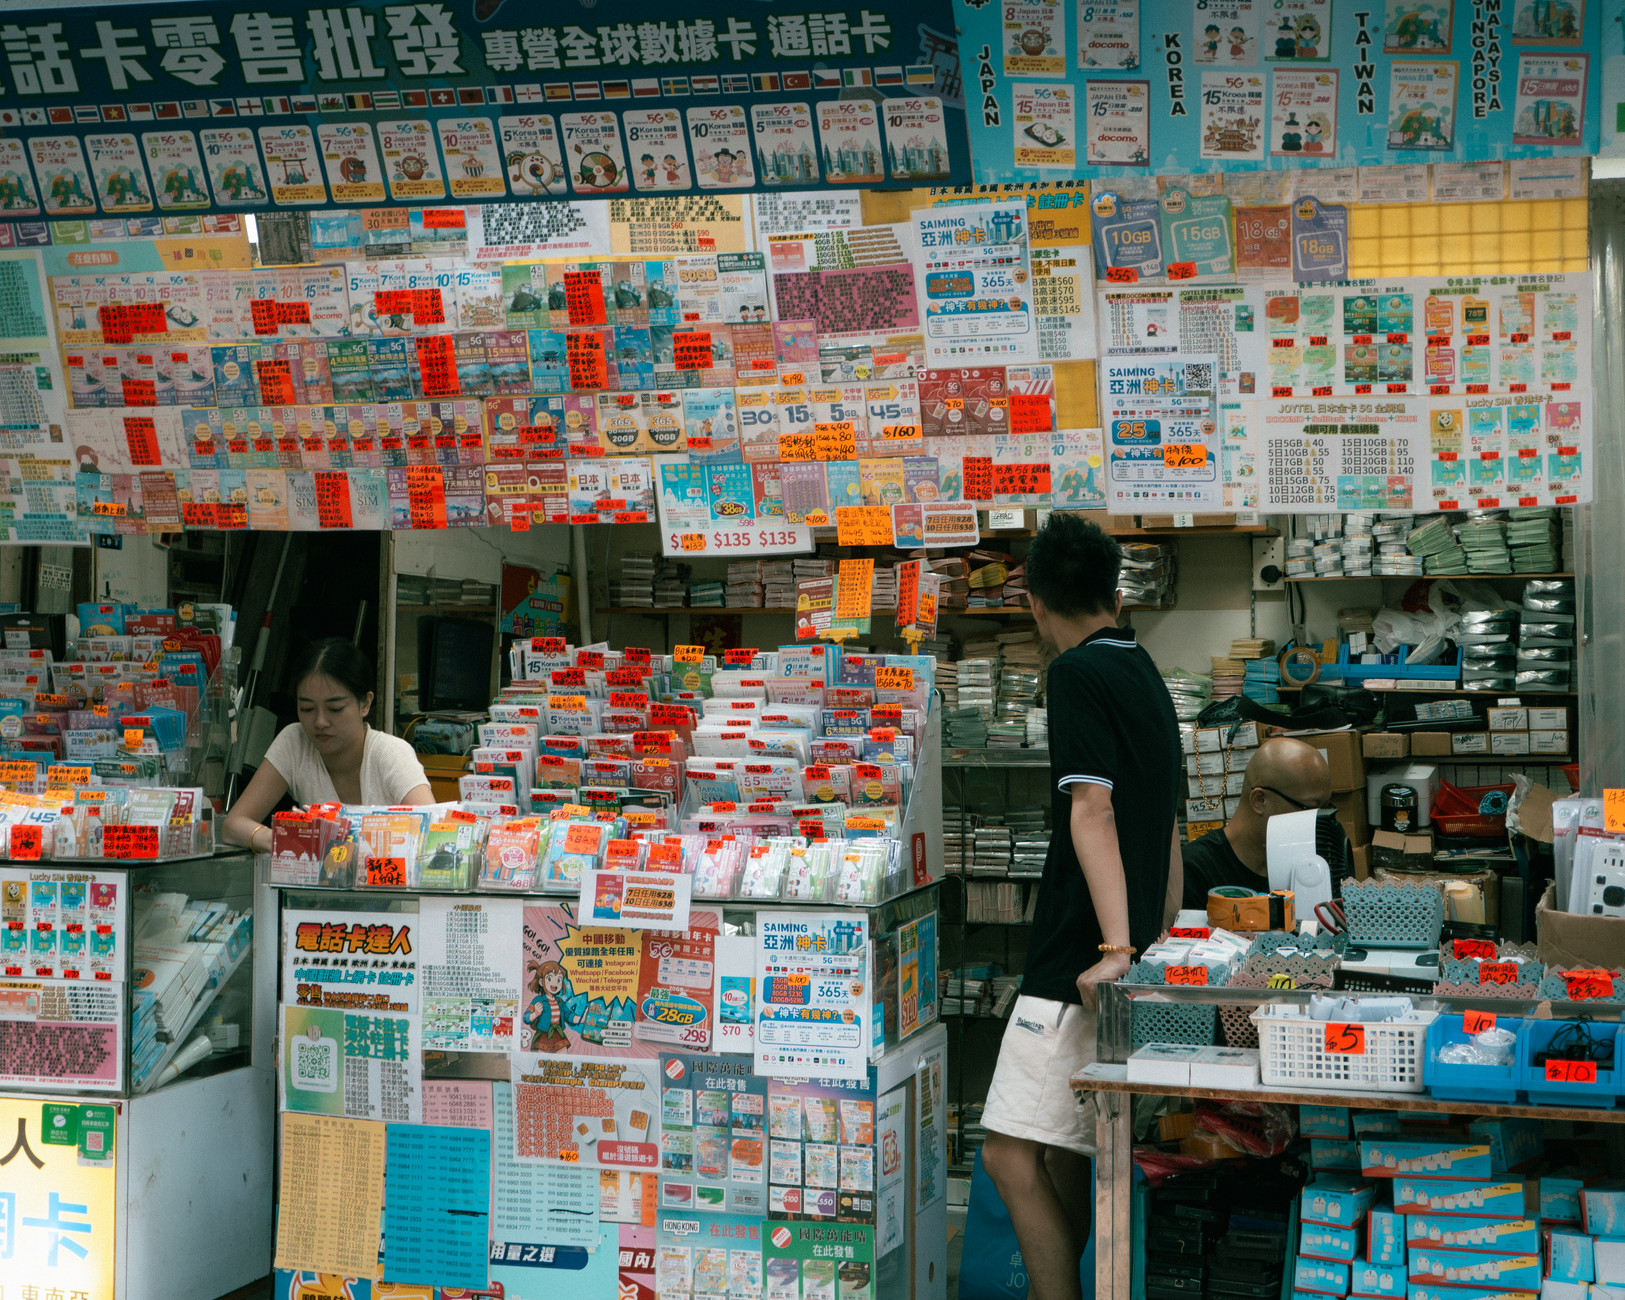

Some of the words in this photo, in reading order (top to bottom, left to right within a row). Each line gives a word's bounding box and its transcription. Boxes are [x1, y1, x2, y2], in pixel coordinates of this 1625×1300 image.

[1017, 8, 1040, 16] Japan
[481, 18, 758, 71] 專營全球數據卡
[767, 9, 892, 58] 通話卡
[1088, 41, 1129, 49] docomo
[1354, 13, 1374, 114] TAIWAN
[1163, 33, 1187, 116] KOREA
[1394, 74, 1417, 82] TAIWAN
[978, 46, 1000, 126] JAPAN
[1202, 90, 1221, 105] 15
[1276, 91, 1293, 105] 15
[1016, 100, 1033, 114] 15
[1033, 101, 1057, 109] Japan
[1091, 102, 1108, 117] 15
[888, 115, 903, 127] 10
[512, 126, 537, 137] Korea
[574, 126, 600, 136] Korea
[639, 125, 663, 135] Korea
[691, 123, 708, 138] 10
[709, 122, 731, 131] Korea
[443, 134, 458, 147] 10
[1098, 134, 1138, 143] docomo
[920, 217, 966, 230] SAIMING
[920, 227, 986, 247] 亞洲神卡
[1111, 229, 1152, 246] 10GB
[1180, 226, 1222, 242] 15GB
[983, 247, 994, 256] 5G
[1301, 239, 1334, 255] 18GB
[455, 272, 471, 287] 15
[679, 269, 717, 283] 50GB
[981, 274, 1014, 288] 365天
[312, 312, 343, 320] docomo
[1109, 367, 1155, 378] SAIMING
[1109, 377, 1176, 395] 亞洲神卡
[1171, 398, 1182, 406] 5G
[1278, 403, 1315, 414] JOYTEL
[1317, 402, 1360, 414] 日本金卡
[1360, 402, 1373, 414] 5G
[1375, 402, 1406, 414] 全網通
[1465, 398, 1494, 409] Lucky
[1495, 397, 1513, 407] SIM
[785, 405, 810, 423] 15
[1265, 415, 1305, 424] DOCOMO
[611, 416, 630, 428] 365
[653, 416, 673, 428] 365
[1118, 421, 1146, 440] 25
[1168, 426, 1201, 438] 365天
[612, 435, 635, 444] 20GB
[654, 433, 677, 443] 10GB
[1268, 439, 1303, 449] 5日5GB
[1341, 438, 1388, 448] 15日10GB
[1268, 448, 1309, 458] 5日10GB
[1341, 447, 1388, 457] 15日15GB
[1268, 457, 1303, 467] 7日7GB
[1341, 456, 1388, 466] 30日20GB
[1397, 456, 1414, 466] 110
[468, 469, 480, 479] 5G
[1268, 467, 1303, 477] 8日8GB
[1341, 465, 1388, 475] 30日30GB
[1397, 465, 1414, 475] 140
[620, 472, 642, 486] 日本
[1268, 476, 1310, 486] 8日15GB
[355, 484, 379, 494] JAPAN
[1269, 485, 1315, 495] 10日12GB
[356, 497, 379, 509] SIM
[1269, 494, 1315, 504] 10日20GB
[926, 515, 974, 525] 7日任用$28
[714, 532, 751, 548] $135
[758, 530, 797, 546] $135
[66, 731, 93, 741] SAIMING
[29, 872, 51, 885] Lucky
[52, 871, 65, 881] SIM
[627, 888, 672, 900] 7日任用$28
[763, 922, 808, 934] SAIMING
[294, 922, 413, 956] 電話卡達人
[582, 933, 626, 946] 中國移動
[763, 934, 827, 952] 亞洲神卡
[648, 940, 673, 959] 5G
[673, 945, 712, 957] 無限上網
[577, 959, 604, 968] 可連接
[604, 959, 634, 970] Instagram
[822, 956, 833, 965] 5G
[569, 969, 601, 979] Whatsapp
[604, 969, 635, 977] Facebook
[575, 977, 600, 985] Wechat
[603, 977, 633, 986] Telegram
[817, 985, 849, 1000] 365天
[656, 1008, 694, 1024] 28GB
[678, 1028, 707, 1044] $298
[722, 1024, 741, 1036] $70
[1548, 1060, 1591, 1082] $10
[705, 1076, 747, 1092] 在此發售
[589, 1088, 606, 1100] $40
[557, 1113, 574, 1124] $60
[557, 1122, 575, 1133] $80
[0, 1117, 46, 1171] 人
[559, 1141, 579, 1152] $120
[819, 1197, 834, 1207] $50
[708, 1222, 760, 1240] 在此發售
[812, 1243, 854, 1259] 在此發售
[618, 1250, 658, 1270] 國內
[1006, 1272, 1030, 1288] JO
